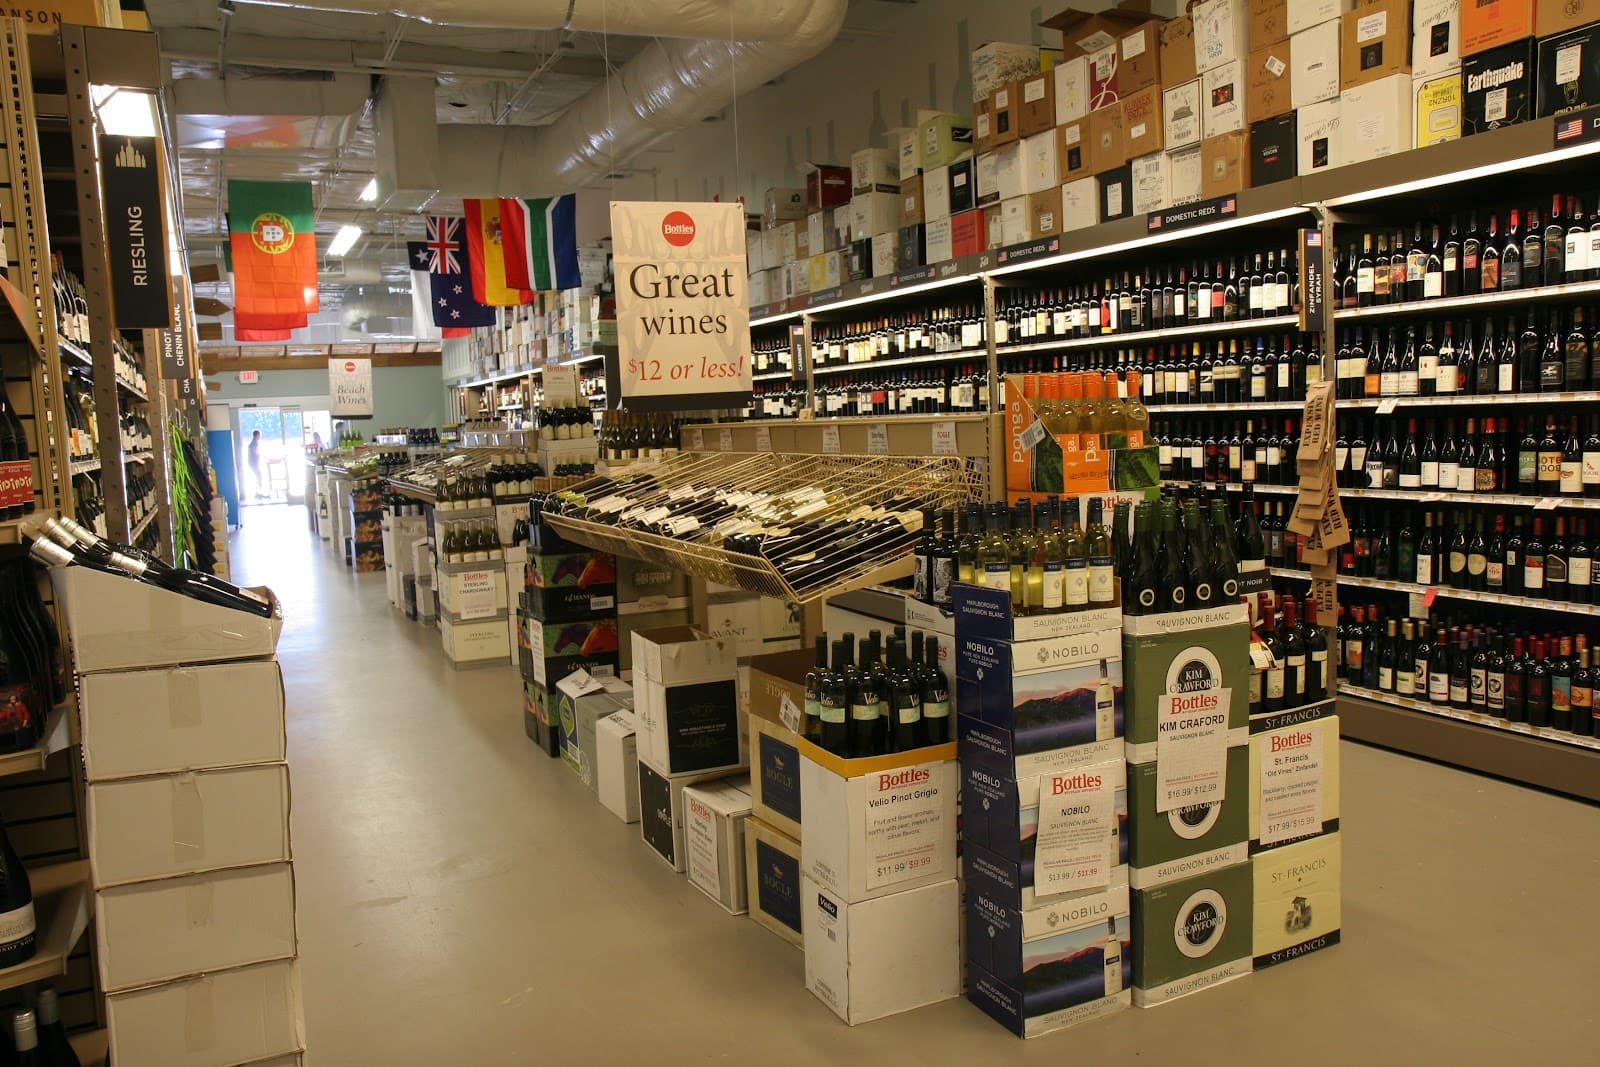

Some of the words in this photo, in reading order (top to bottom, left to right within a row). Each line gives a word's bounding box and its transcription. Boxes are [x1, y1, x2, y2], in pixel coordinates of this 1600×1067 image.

[1467, 61, 1524, 94] Earthquake
[1165, 209, 1198, 224] DOMESTIC
[1198, 206, 1216, 216] REDS
[664, 224, 695, 235] Bottles
[133, 205, 148, 287] RIESLING
[1009, 247, 1032, 258] DOMESTIC
[1032, 245, 1046, 253] REDS
[629, 263, 736, 300] Great
[174, 303, 183, 333] BLANC
[641, 308, 729, 336] wines
[163, 331, 173, 358] PINOT
[175, 334, 185, 367] CHENIN
[628, 358, 662, 382] $12
[670, 364, 695, 381] or
[700, 355, 745, 379] less!
[337, 383, 366, 395] Beach
[1302, 399, 1315, 447] EXPENSIV
[1311, 424, 1321, 444] RED
[1033, 615, 1080, 628] SAUVIGNON
[1081, 612, 1108, 623] BLANC
[1156, 615, 1204, 628] SAUVIGNON
[1205, 611, 1231, 622] BLANC
[966, 641, 994, 656] NOBILO
[1052, 643, 1100, 660] NOBILO
[1185, 669, 1203, 681] KIM
[1169, 678, 1219, 694] CRAWFORD
[1170, 694, 1218, 715] Bottles
[1159, 721, 1177, 732] KIM
[1179, 714, 1225, 730] CRAFORD
[1169, 732, 1198, 741] SAUVIGNON
[1198, 729, 1215, 738] BLANC
[1270, 731, 1313, 753] Bottles
[1034, 751, 1081, 764] SAUVIGNON
[1083, 743, 1110, 755] BLANC
[1274, 757, 1283, 766] St.
[1285, 753, 1309, 765] Francis
[878, 768, 930, 792] Bottles
[972, 769, 1000, 788] NOBILO
[1052, 773, 1102, 796] Bottles
[868, 798, 889, 808] Velio
[891, 793, 913, 804] Pinot
[913, 787, 938, 799] Grigio
[690, 798, 712, 823] Bottles
[1060, 805, 1091, 816] NOBILO
[1049, 821, 1081, 830] SAUVIGNON
[1081, 817, 1099, 826] BLANC
[908, 856, 931, 869] $9.99
[1157, 860, 1204, 878] SAUVIGNON
[1205, 852, 1231, 865] BLANC
[819, 895, 835, 914] Velio
[978, 895, 1006, 918] NOBILO
[1062, 902, 1108, 923] NOBILO
[1193, 908, 1210, 922] KIM
[1177, 915, 1224, 938] CRAWFORD
[1164, 975, 1210, 998] SAUVIGNON
[1211, 967, 1235, 983] BLANC
[1044, 1007, 1089, 1024] SAUVIGNON
[1092, 996, 1118, 1012] BLANC
